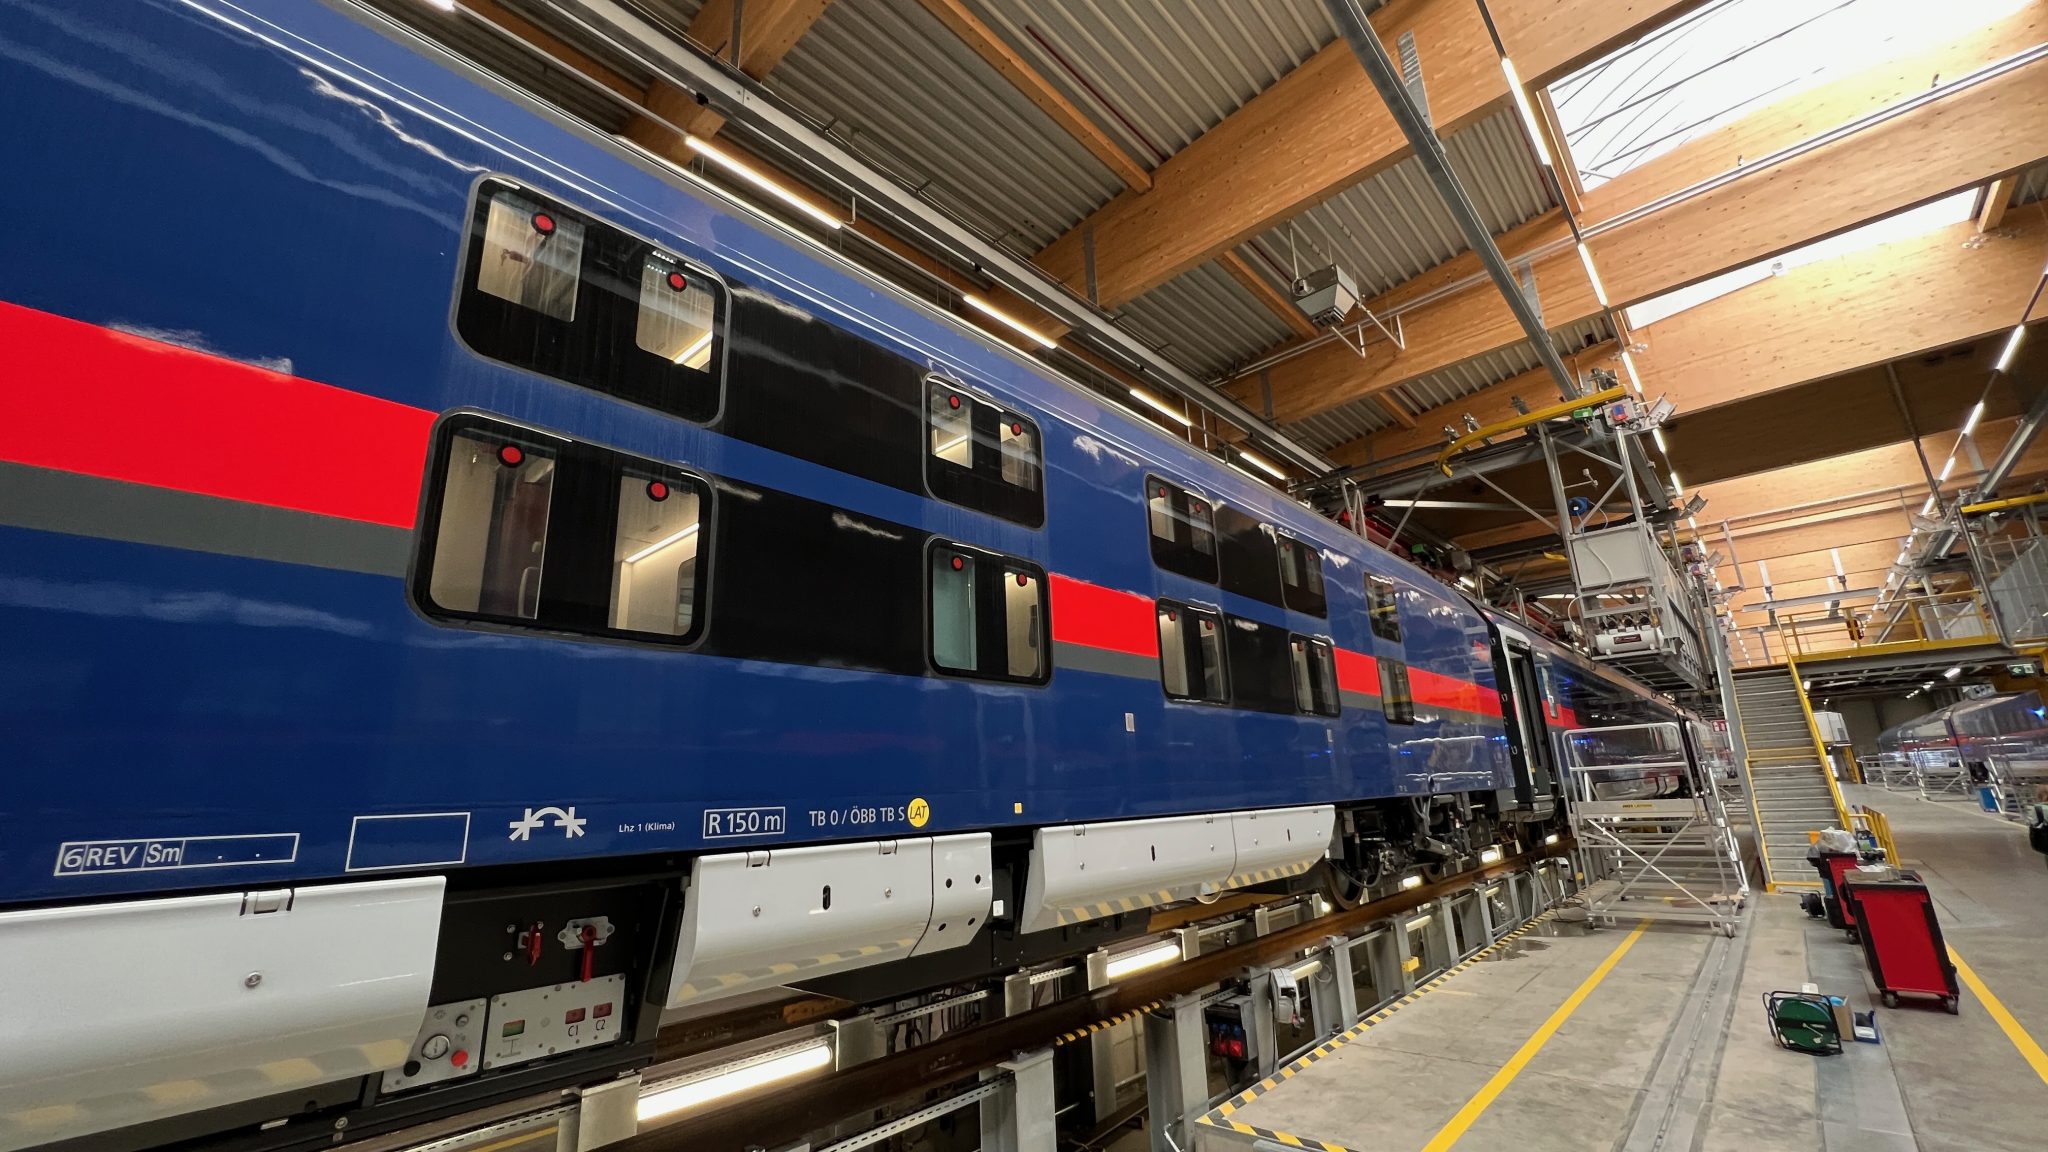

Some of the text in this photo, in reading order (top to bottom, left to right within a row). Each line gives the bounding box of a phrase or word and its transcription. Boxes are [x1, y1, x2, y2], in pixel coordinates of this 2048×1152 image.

[808, 810, 826, 827] TB
[841, 809, 848, 825] /
[850, 805, 877, 824] ÖBB
[879, 807, 895, 822] TB
[898, 806, 905, 821] S
[909, 805, 928, 820] LAT
[618, 821, 675, 833] Lhz 1 (Klima)
[708, 811, 781, 834] R 150 m
[63, 843, 180, 868] 6 REV Sm
[568, 1025, 579, 1037] C1
[596, 1019, 606, 1031] C2
